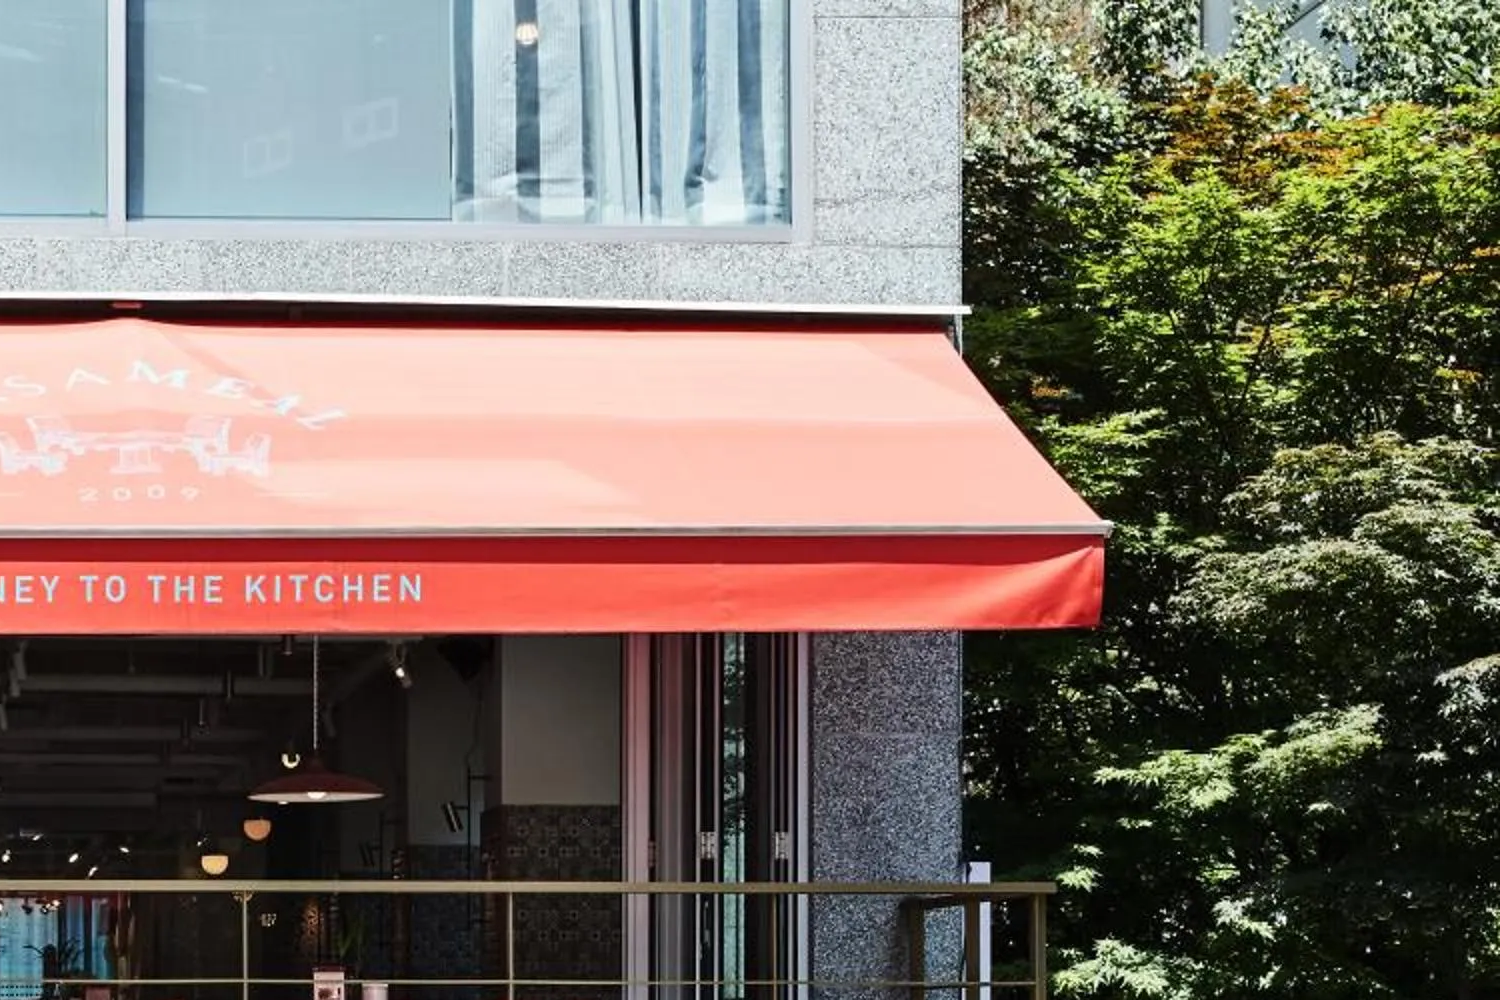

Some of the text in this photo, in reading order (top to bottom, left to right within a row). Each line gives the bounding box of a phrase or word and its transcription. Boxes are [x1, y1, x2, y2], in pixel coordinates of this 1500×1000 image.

[76, 484, 200, 503] 2009
[79, 575, 127, 604] TO
[147, 575, 224, 604] THE
[244, 574, 422, 604] KITCHEN
